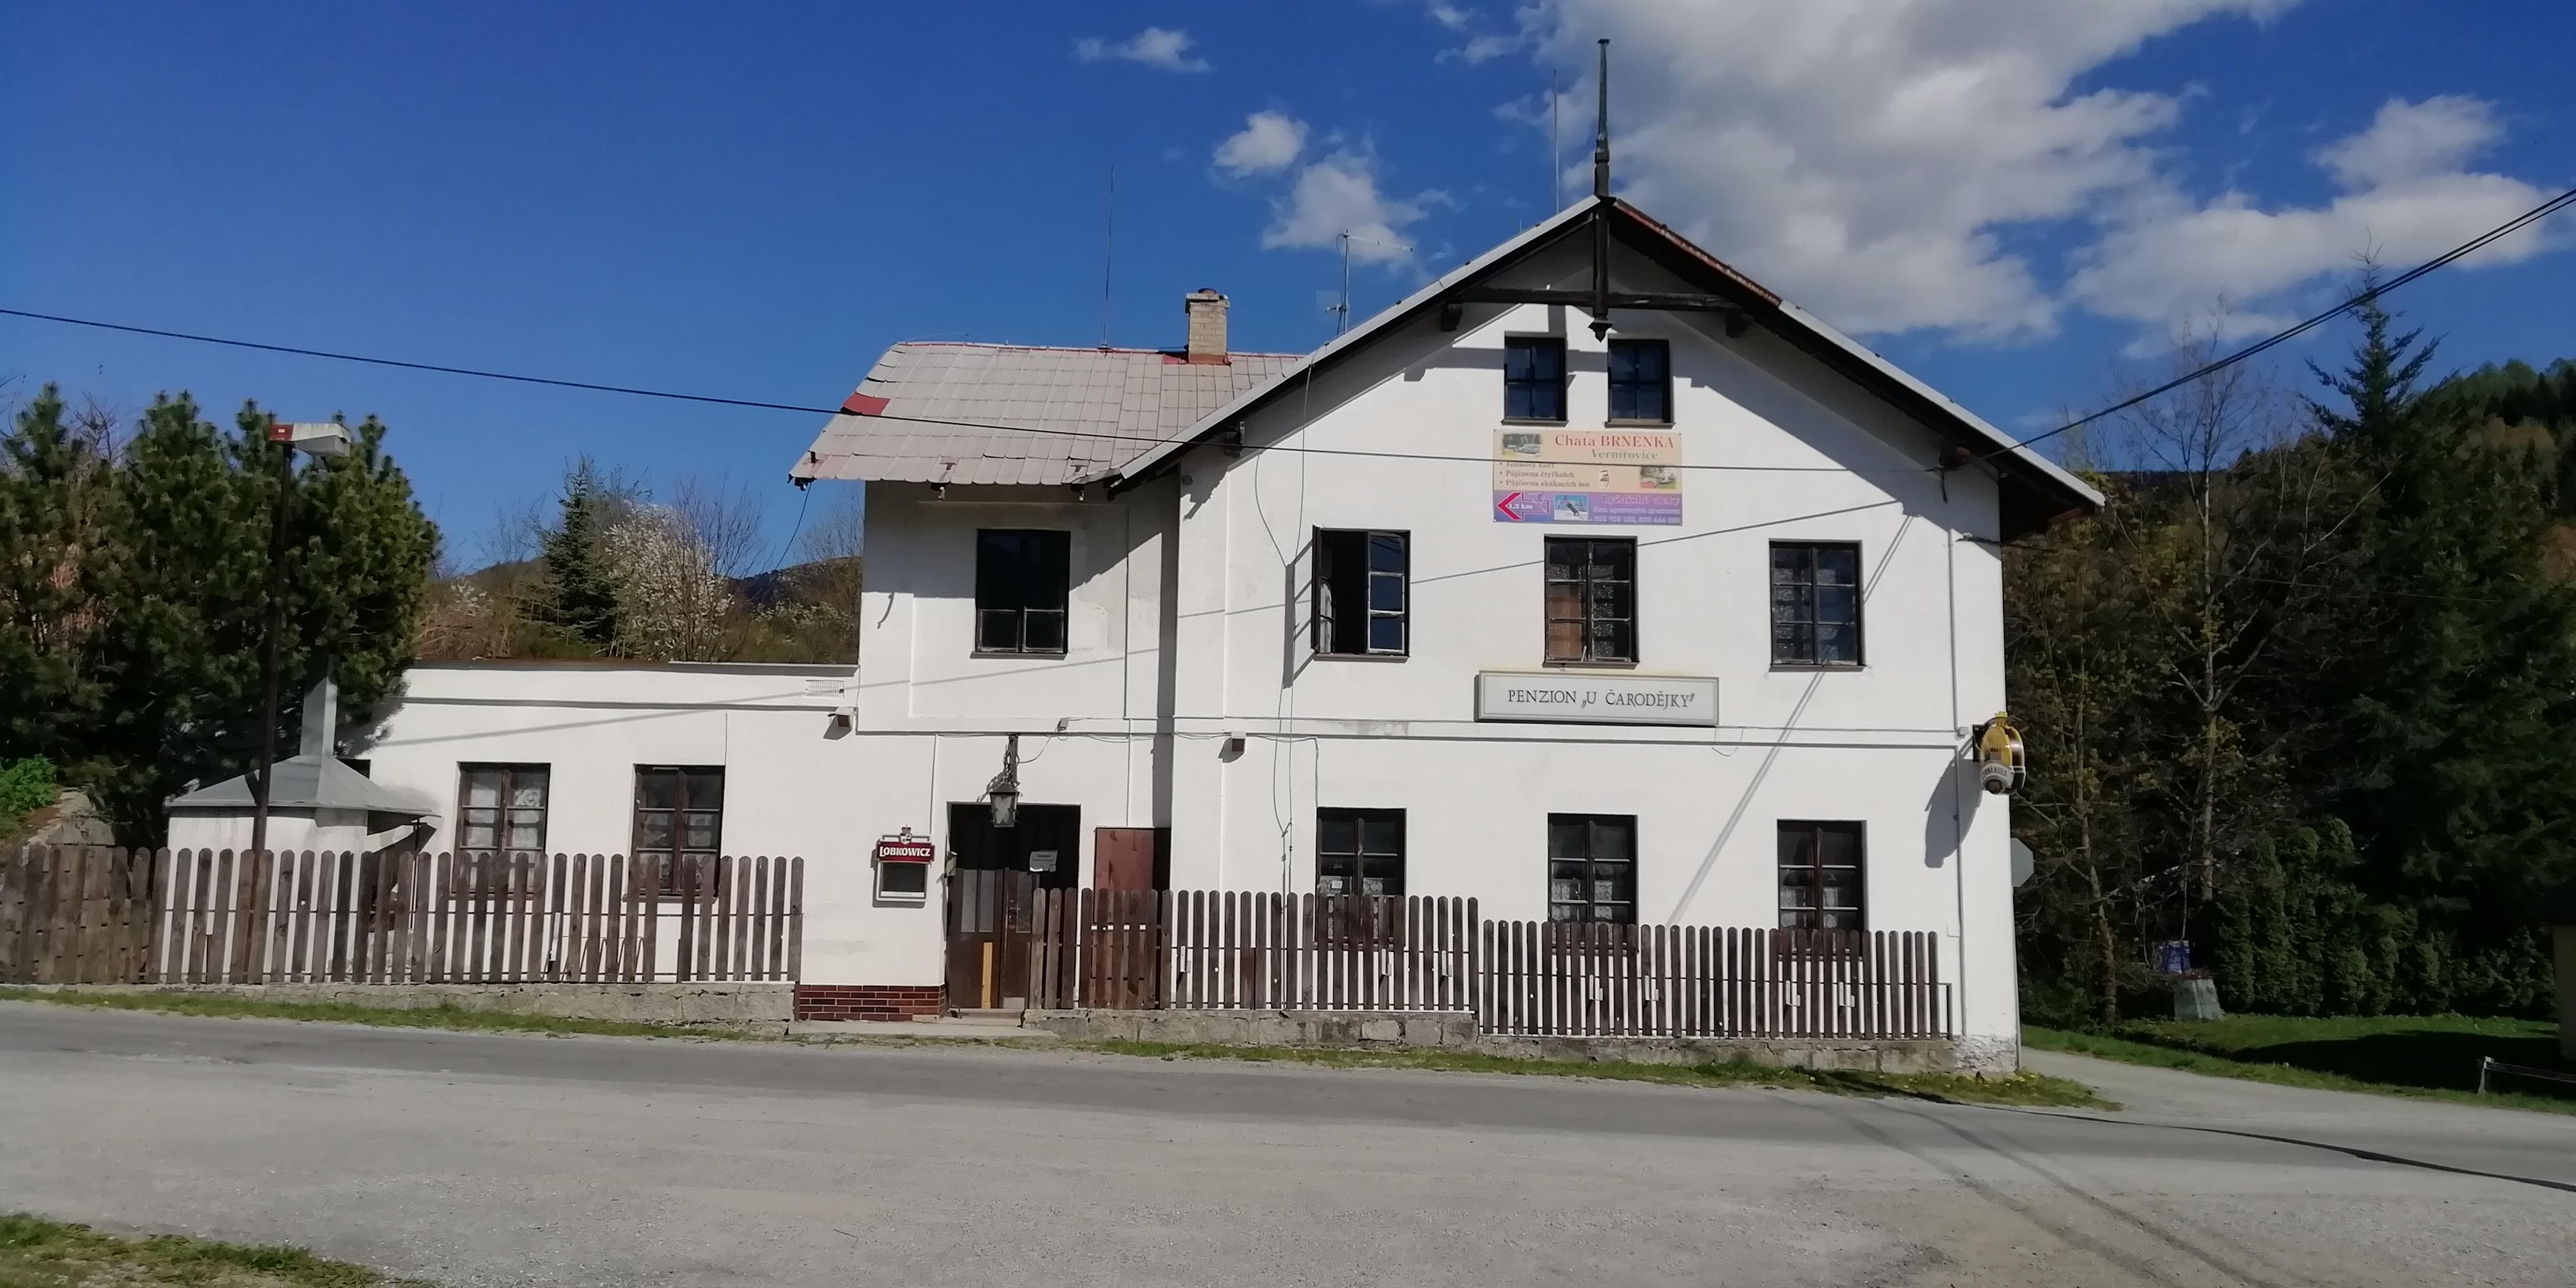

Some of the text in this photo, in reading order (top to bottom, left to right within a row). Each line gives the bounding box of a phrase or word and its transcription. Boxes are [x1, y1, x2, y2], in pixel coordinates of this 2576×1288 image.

[1555, 434, 1595, 446] Chata
[1508, 689, 1577, 703] PENZION
[879, 846, 931, 857] LOBKOWICZ
